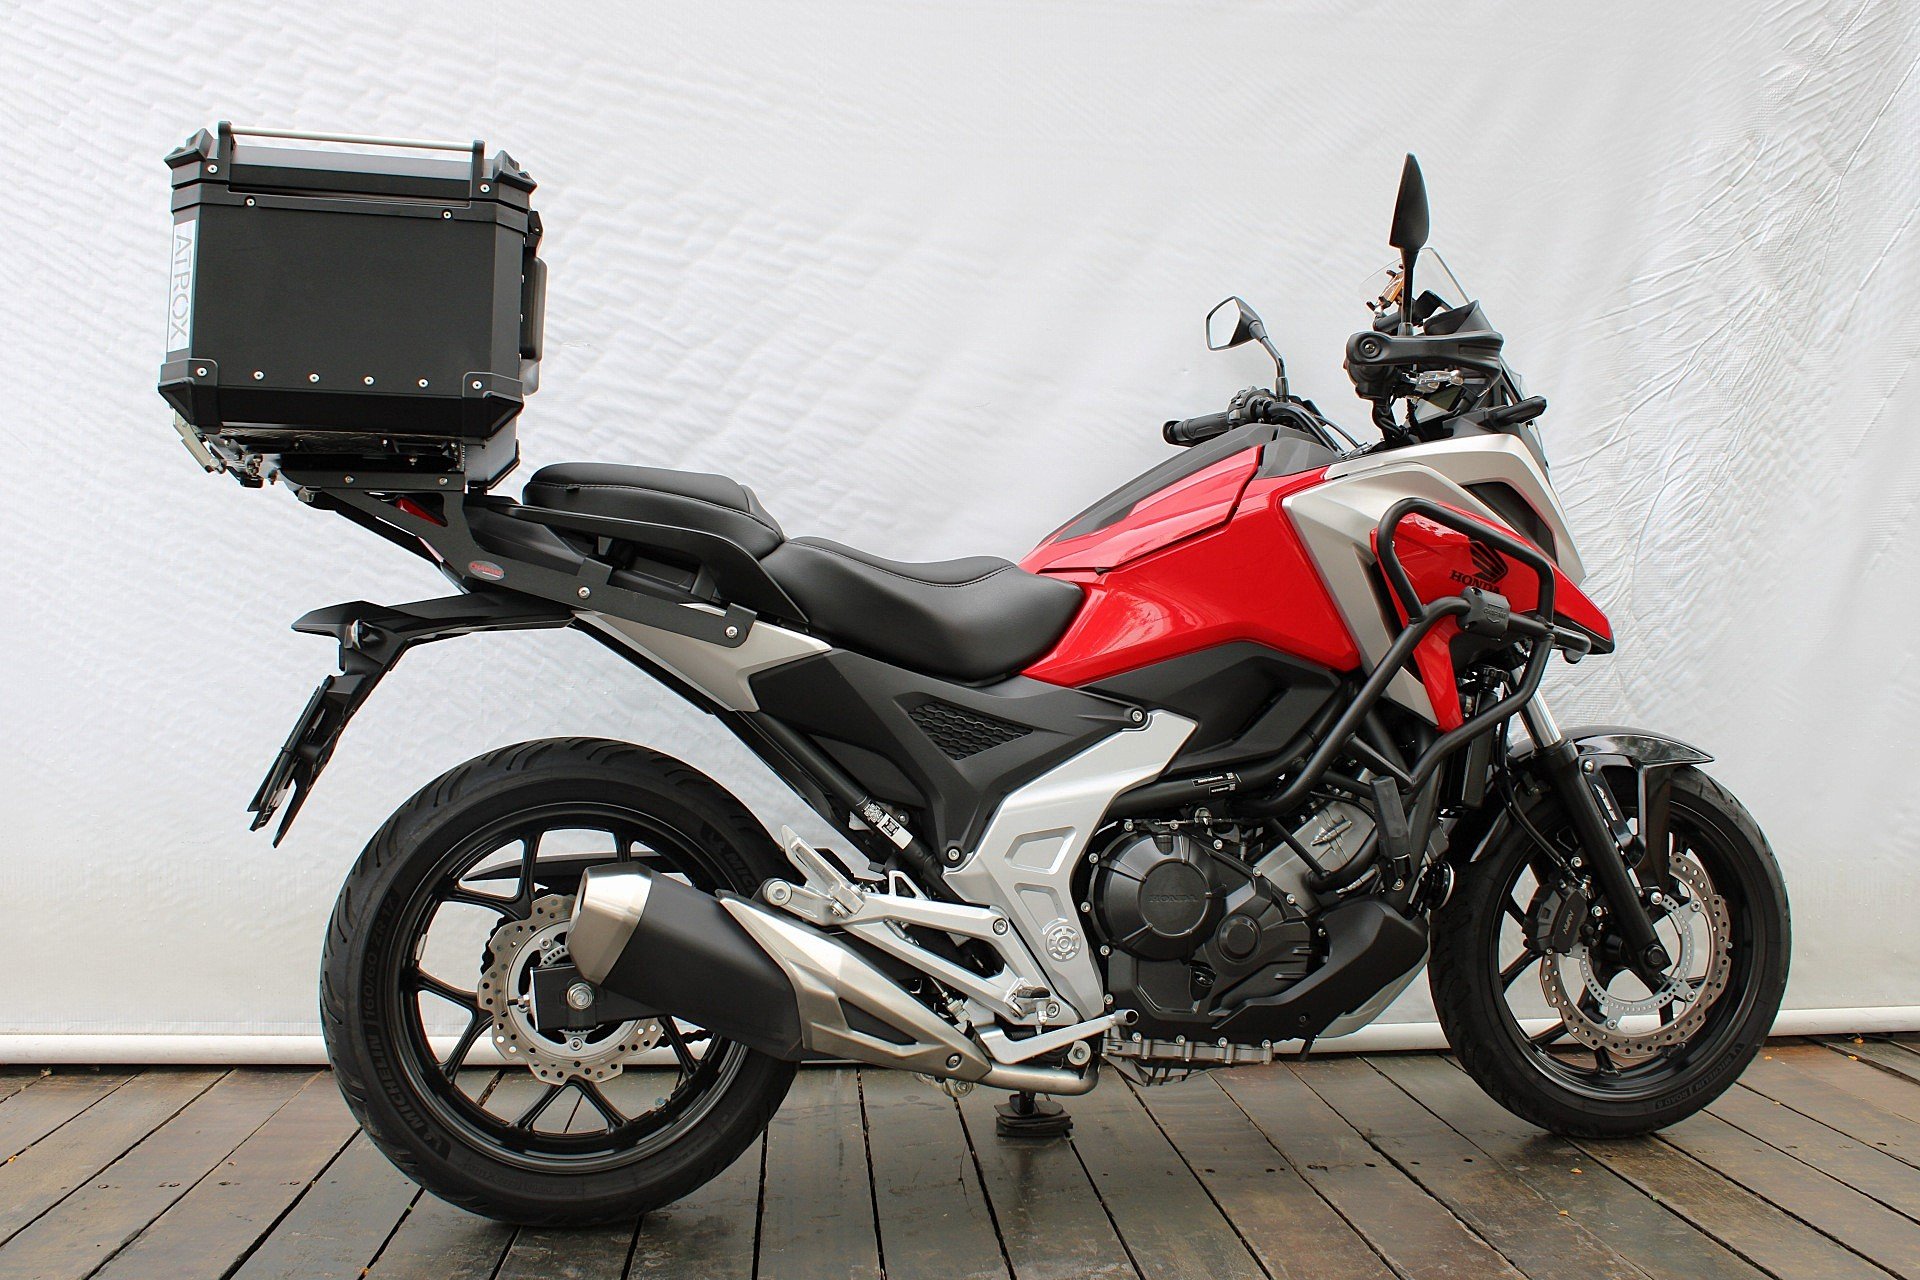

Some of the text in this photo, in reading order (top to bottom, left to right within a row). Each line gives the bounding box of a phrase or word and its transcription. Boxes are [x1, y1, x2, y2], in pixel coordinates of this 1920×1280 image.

[170, 235, 192, 341] ATROX
[1449, 570, 1500, 594] HONDA
[1147, 894, 1198, 903] HONDA
[372, 922, 387, 945] ZR
[362, 955, 378, 1018] 160/60
[365, 1034, 425, 1131] MICHELIN
